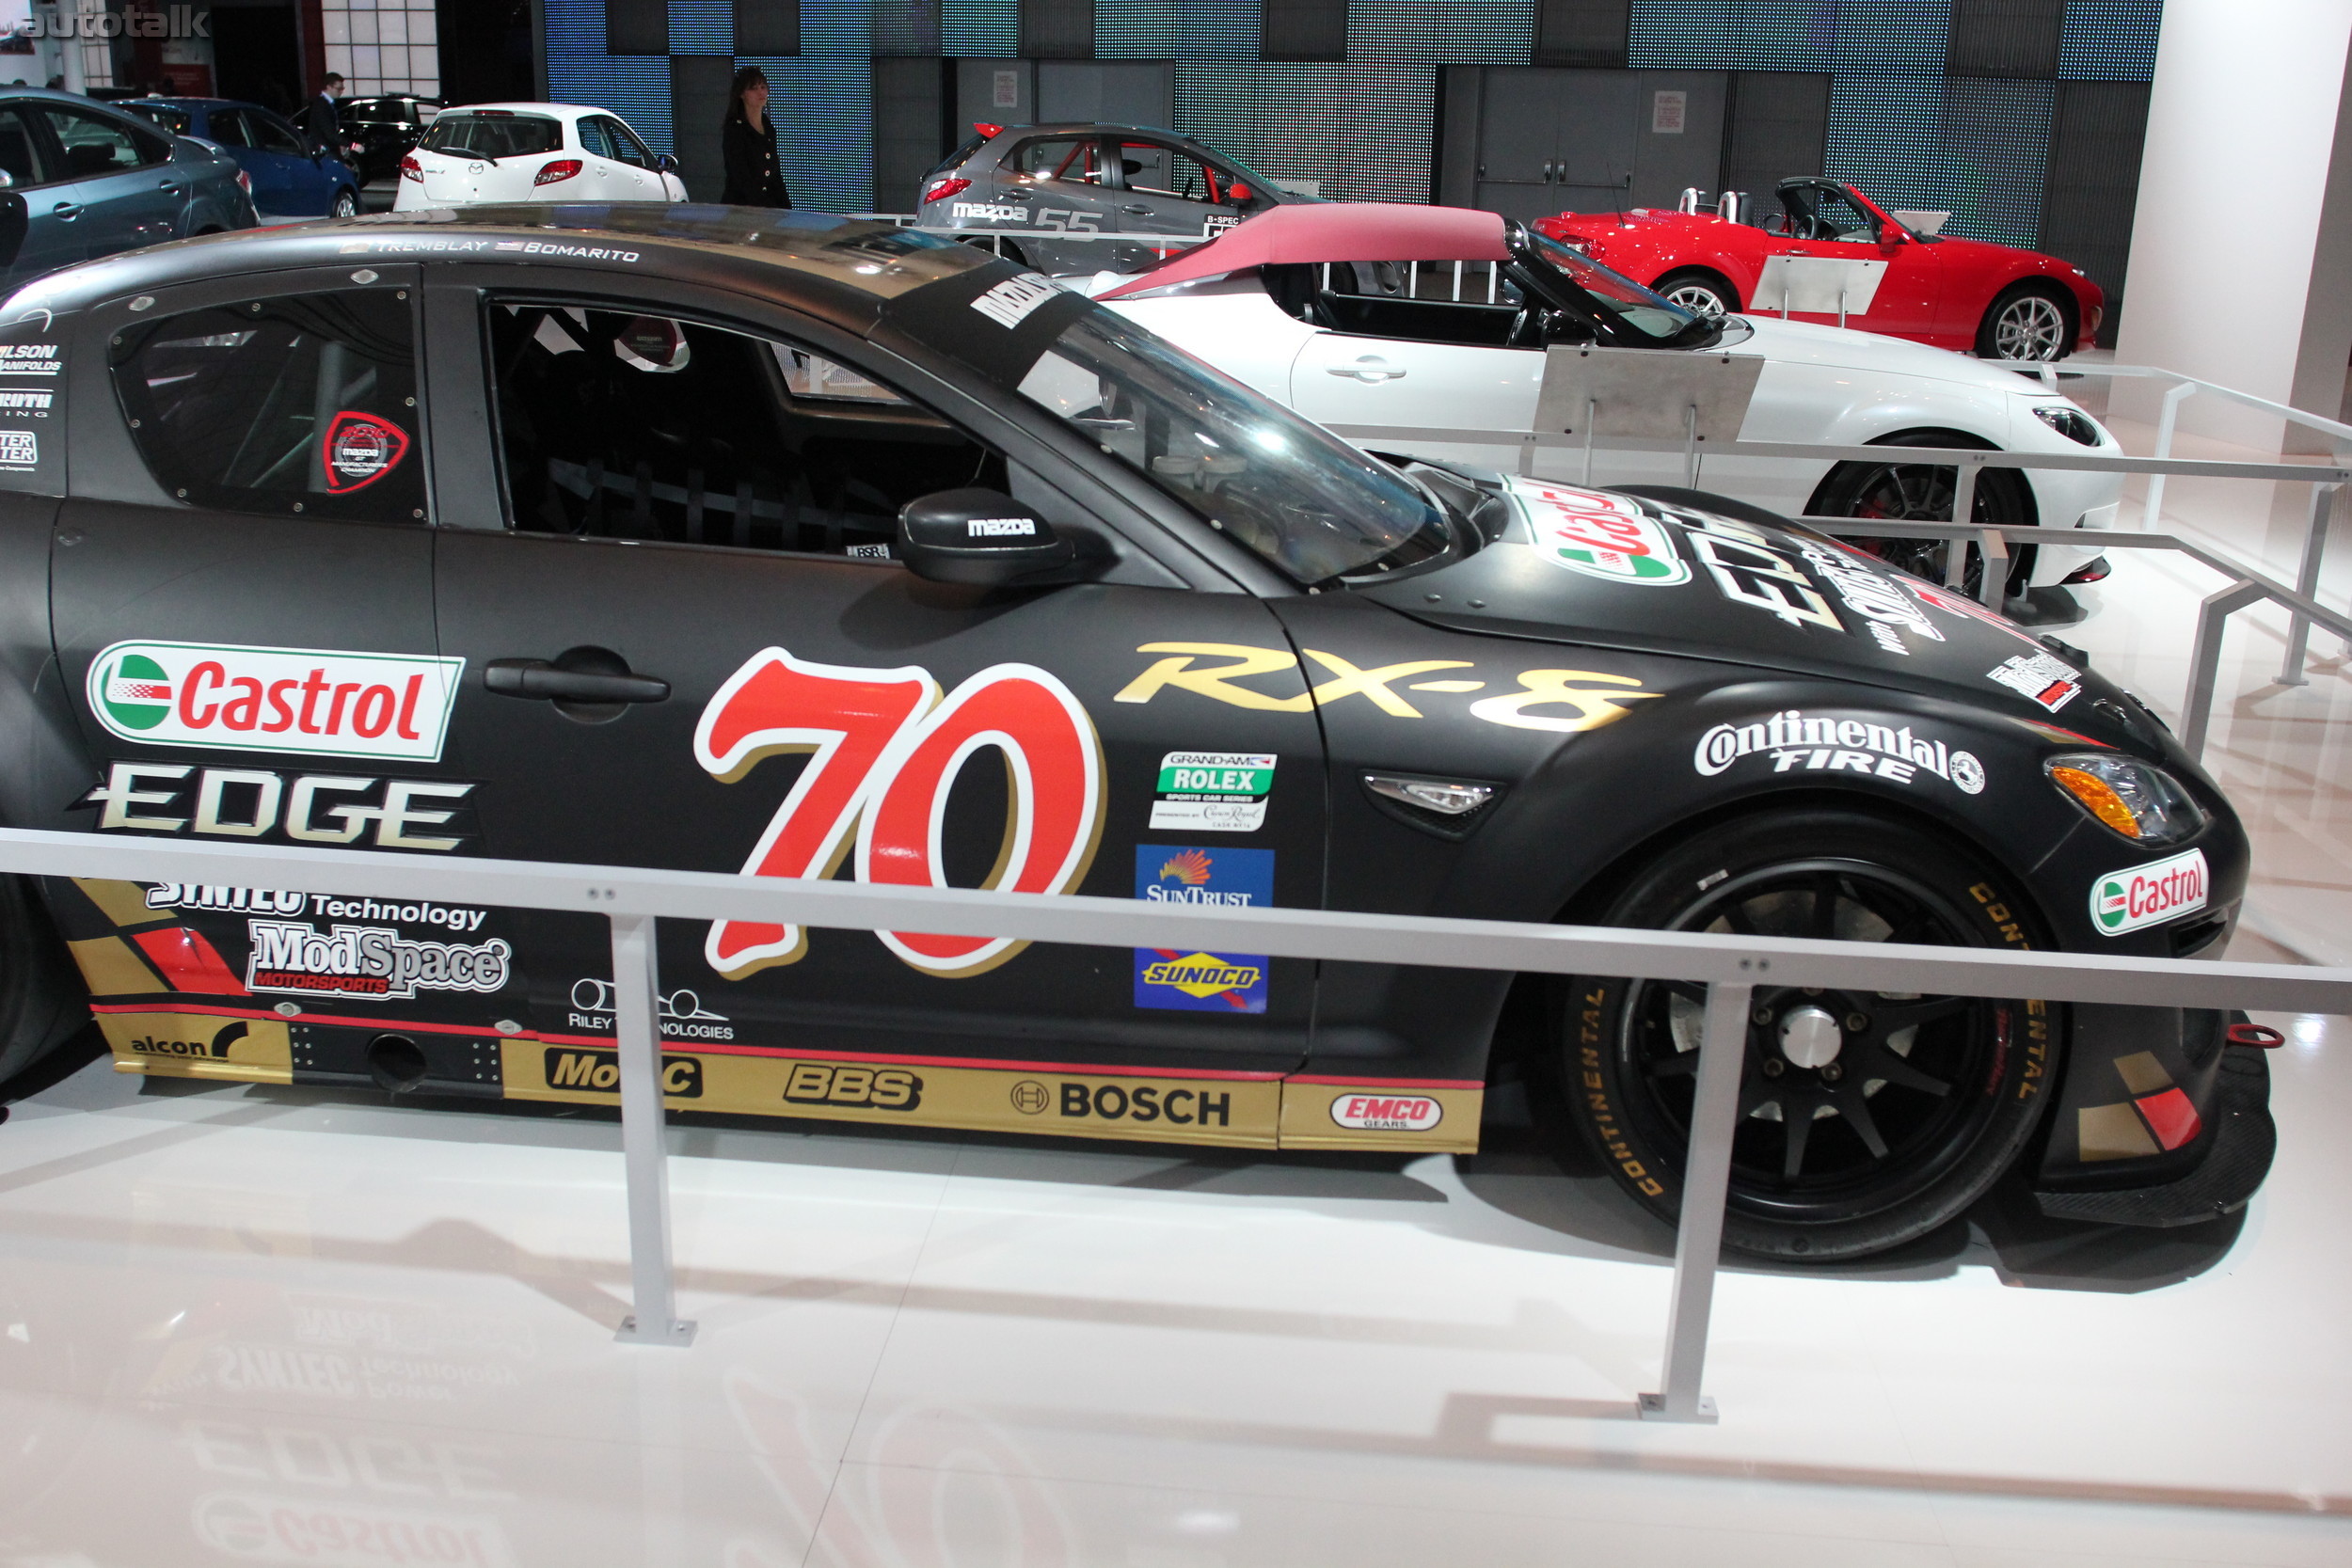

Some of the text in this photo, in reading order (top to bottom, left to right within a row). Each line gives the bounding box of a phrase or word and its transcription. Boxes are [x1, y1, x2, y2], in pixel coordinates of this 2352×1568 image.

[1035, 208, 1104, 242] 55
[376, 240, 488, 252] TREMBLAY
[523, 241, 641, 263] BOMARITO
[0, 344, 58, 358] ILSON
[0, 410, 48, 419] ING
[967, 518, 1036, 537] mazda
[178, 660, 424, 740] Castrol
[1113, 641, 1664, 732] RX-8
[1694, 710, 1951, 777] Continental
[1173, 768, 1256, 791] ROLEX
[1769, 748, 1916, 784] TIRE
[87, 760, 477, 852] EDGE
[693, 645, 1108, 980] 70
[2129, 860, 2203, 918] Castrol
[310, 894, 487, 930] Technology
[257, 927, 506, 990] ModSpace
[1148, 965, 1256, 986] SUNOCO
[254, 972, 390, 993] MOTORSPORTS
[1969, 882, 2047, 1100] CONENTAL
[568, 1012, 613, 1030] RILEY
[131, 1036, 207, 1056] alcon
[552, 1053, 696, 1094] MoC
[783, 1063, 924, 1112] BBS
[1581, 990, 1664, 1187] CONTINENTAL
[1060, 1083, 1231, 1127] BOSCH
[1344, 1098, 1432, 1121] EMCO
[1364, 1119, 1407, 1129] GEARS
